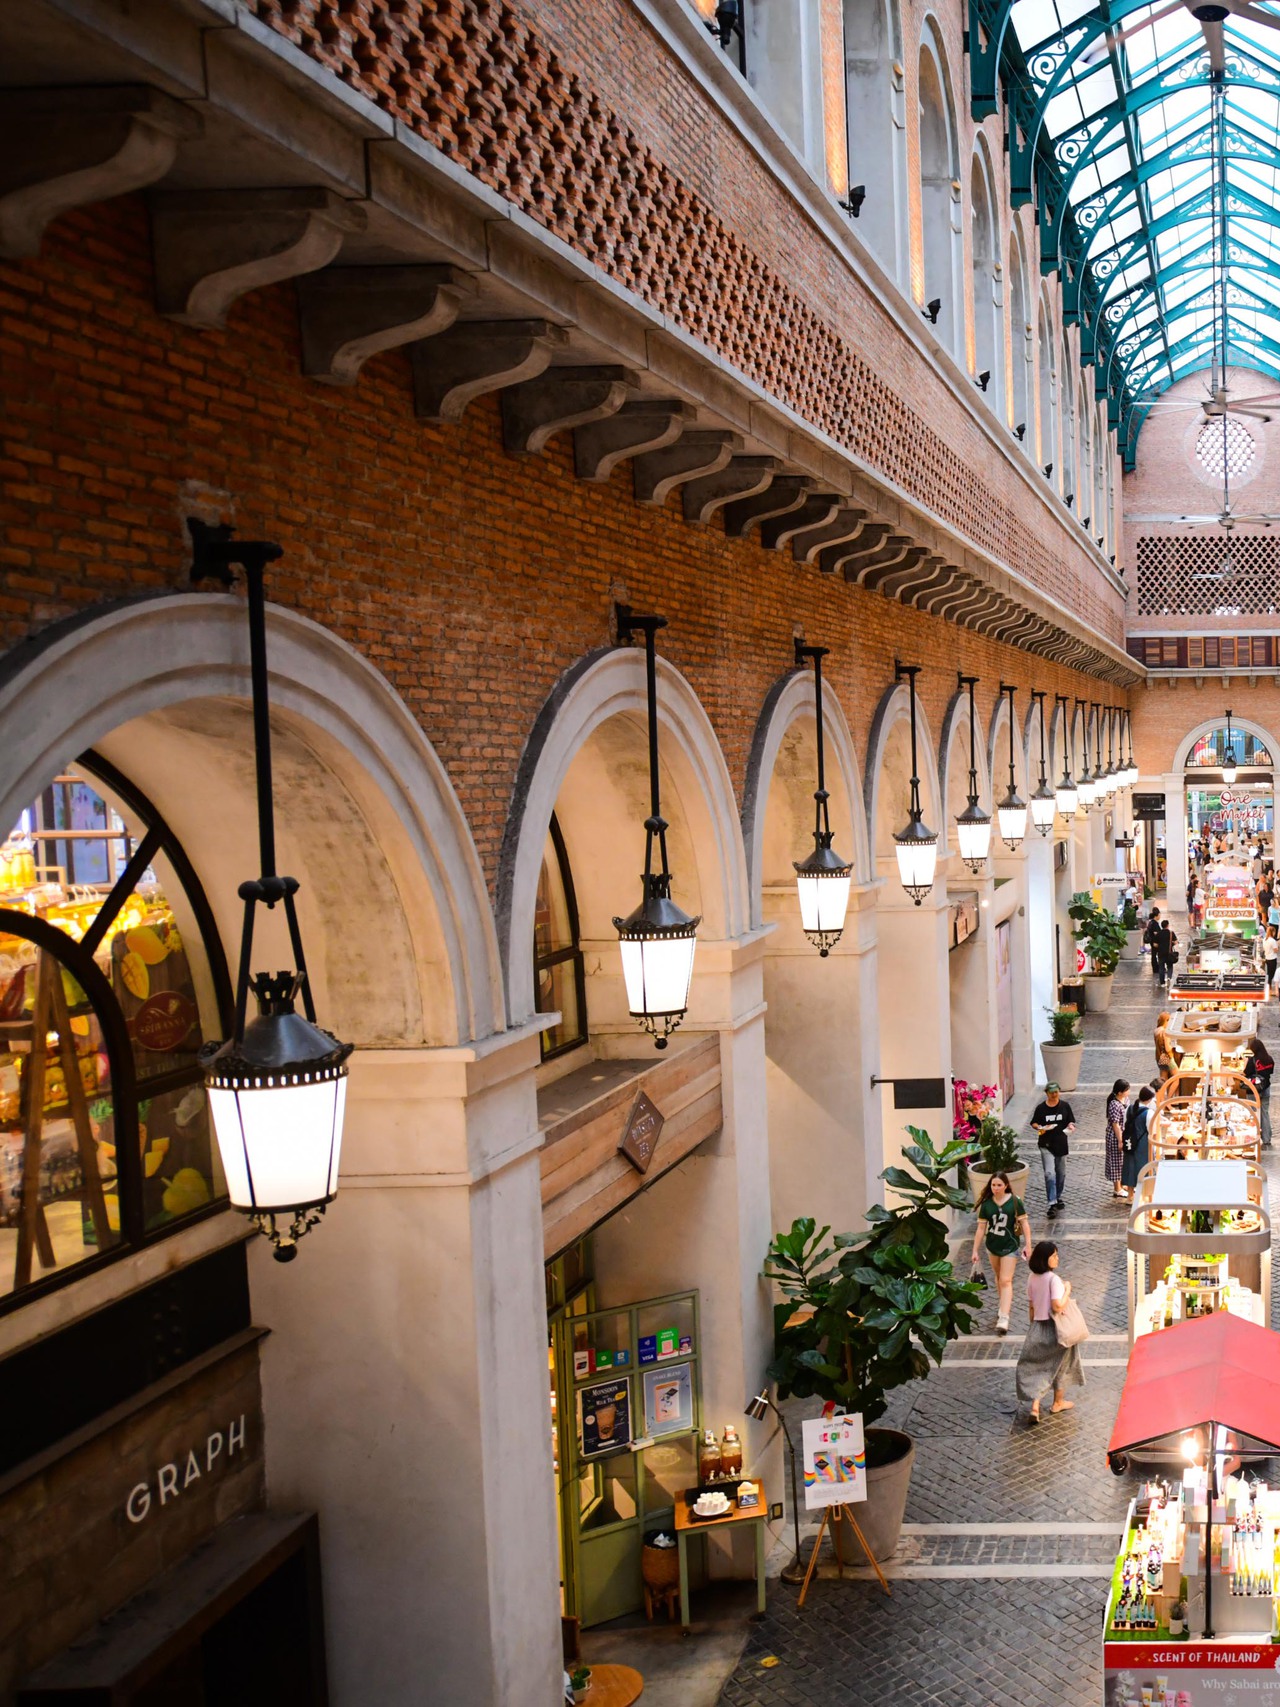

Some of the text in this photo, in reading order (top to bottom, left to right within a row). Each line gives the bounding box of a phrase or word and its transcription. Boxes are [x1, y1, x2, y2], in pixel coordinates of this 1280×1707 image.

[1221, 791, 1253, 805] One
[1220, 806, 1265, 822] Market
[990, 1213, 1008, 1237] 12
[592, 1386, 618, 1396] MONSOON
[126, 1414, 245, 1523] GRAPH
[1152, 1651, 1261, 1663] SCENT OF THAILAND
[1201, 1679, 1226, 1693] Why
[1229, 1679, 1259, 1689] Sabai
